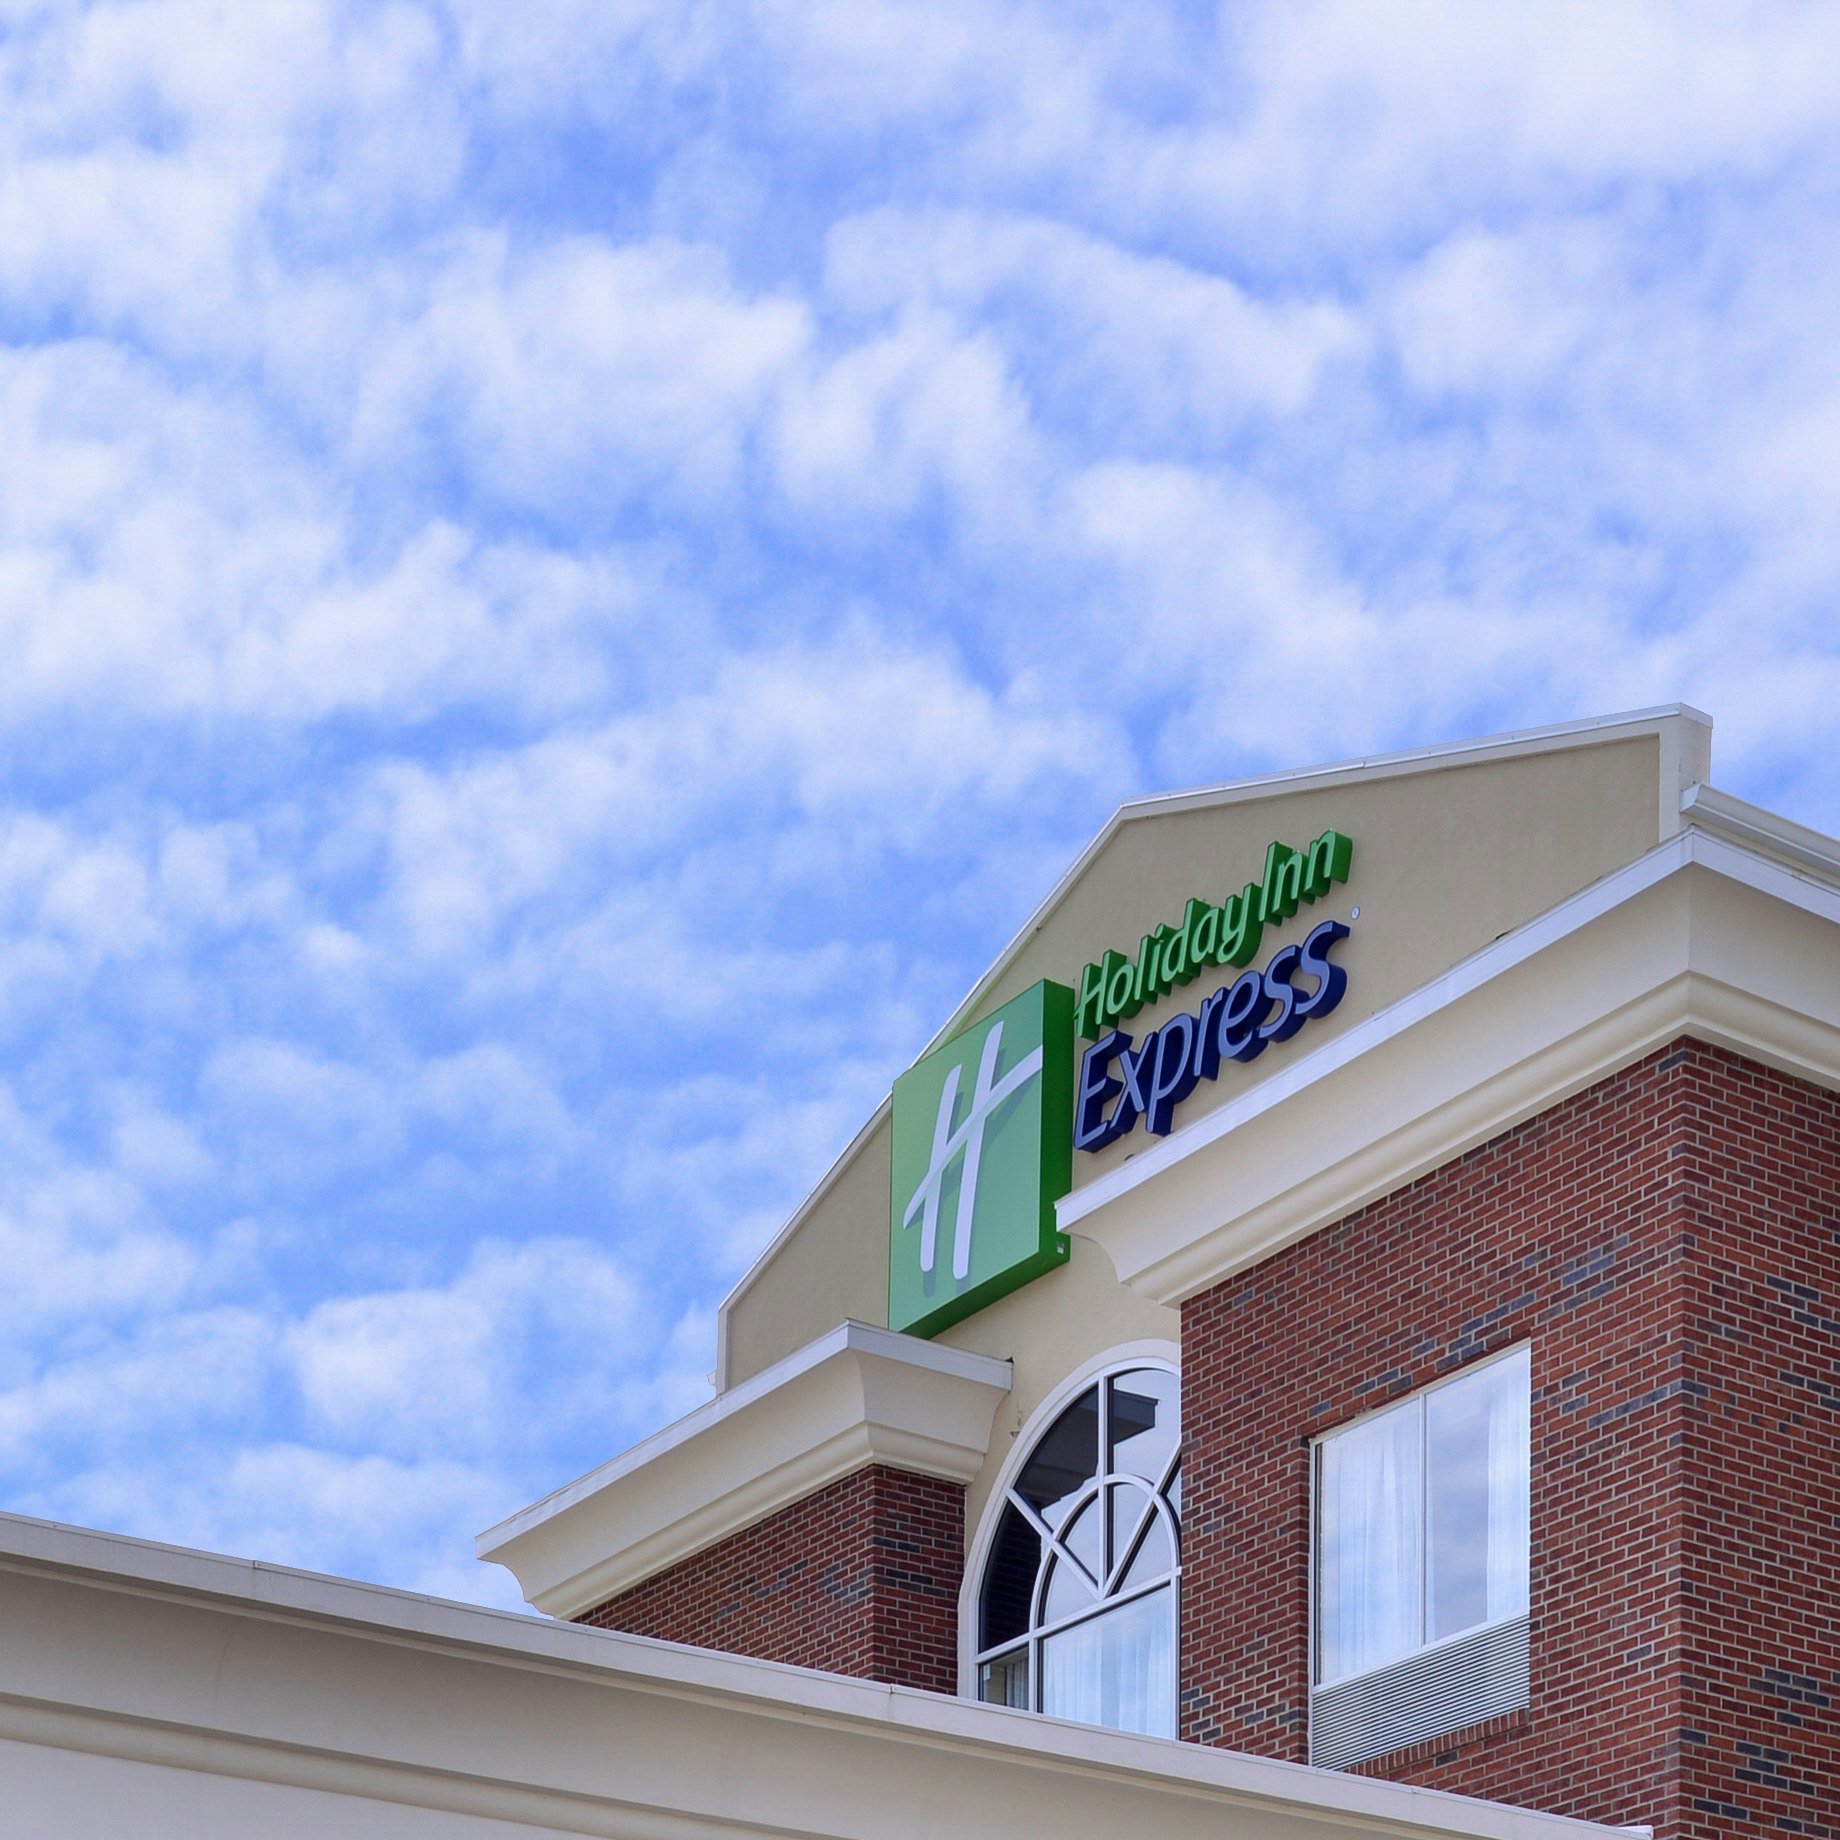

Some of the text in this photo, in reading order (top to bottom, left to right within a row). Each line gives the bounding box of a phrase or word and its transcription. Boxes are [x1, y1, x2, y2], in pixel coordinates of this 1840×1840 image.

[1073, 828, 1353, 1040] Holiday Inn
[1073, 920, 1351, 1153] Express
